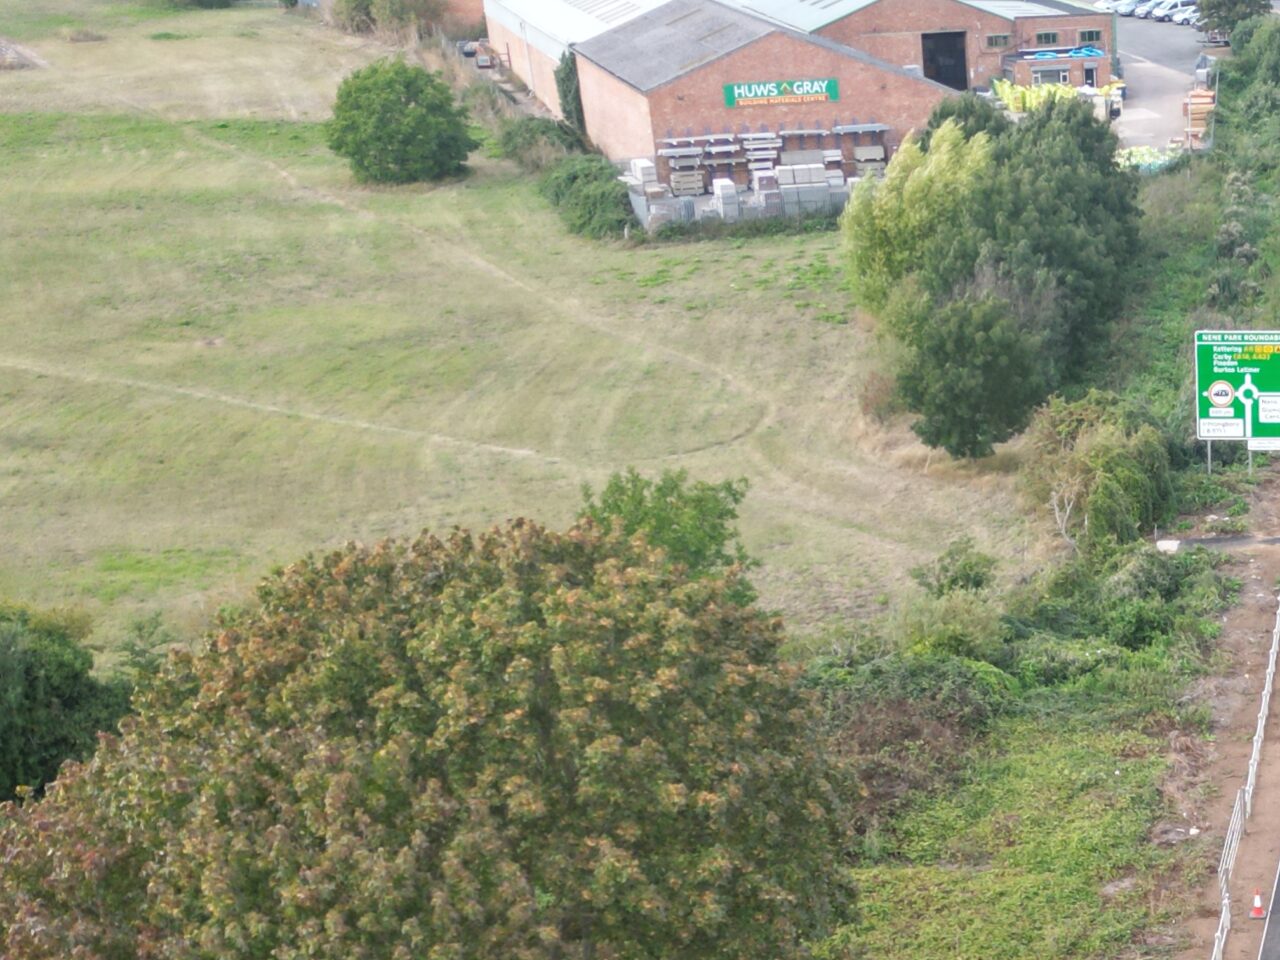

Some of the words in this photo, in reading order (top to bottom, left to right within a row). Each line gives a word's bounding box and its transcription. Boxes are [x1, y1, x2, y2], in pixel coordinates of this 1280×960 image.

[733, 83, 778, 98] HUWS
[793, 80, 828, 94] GRAY
[1213, 353, 1232, 361] Corby
